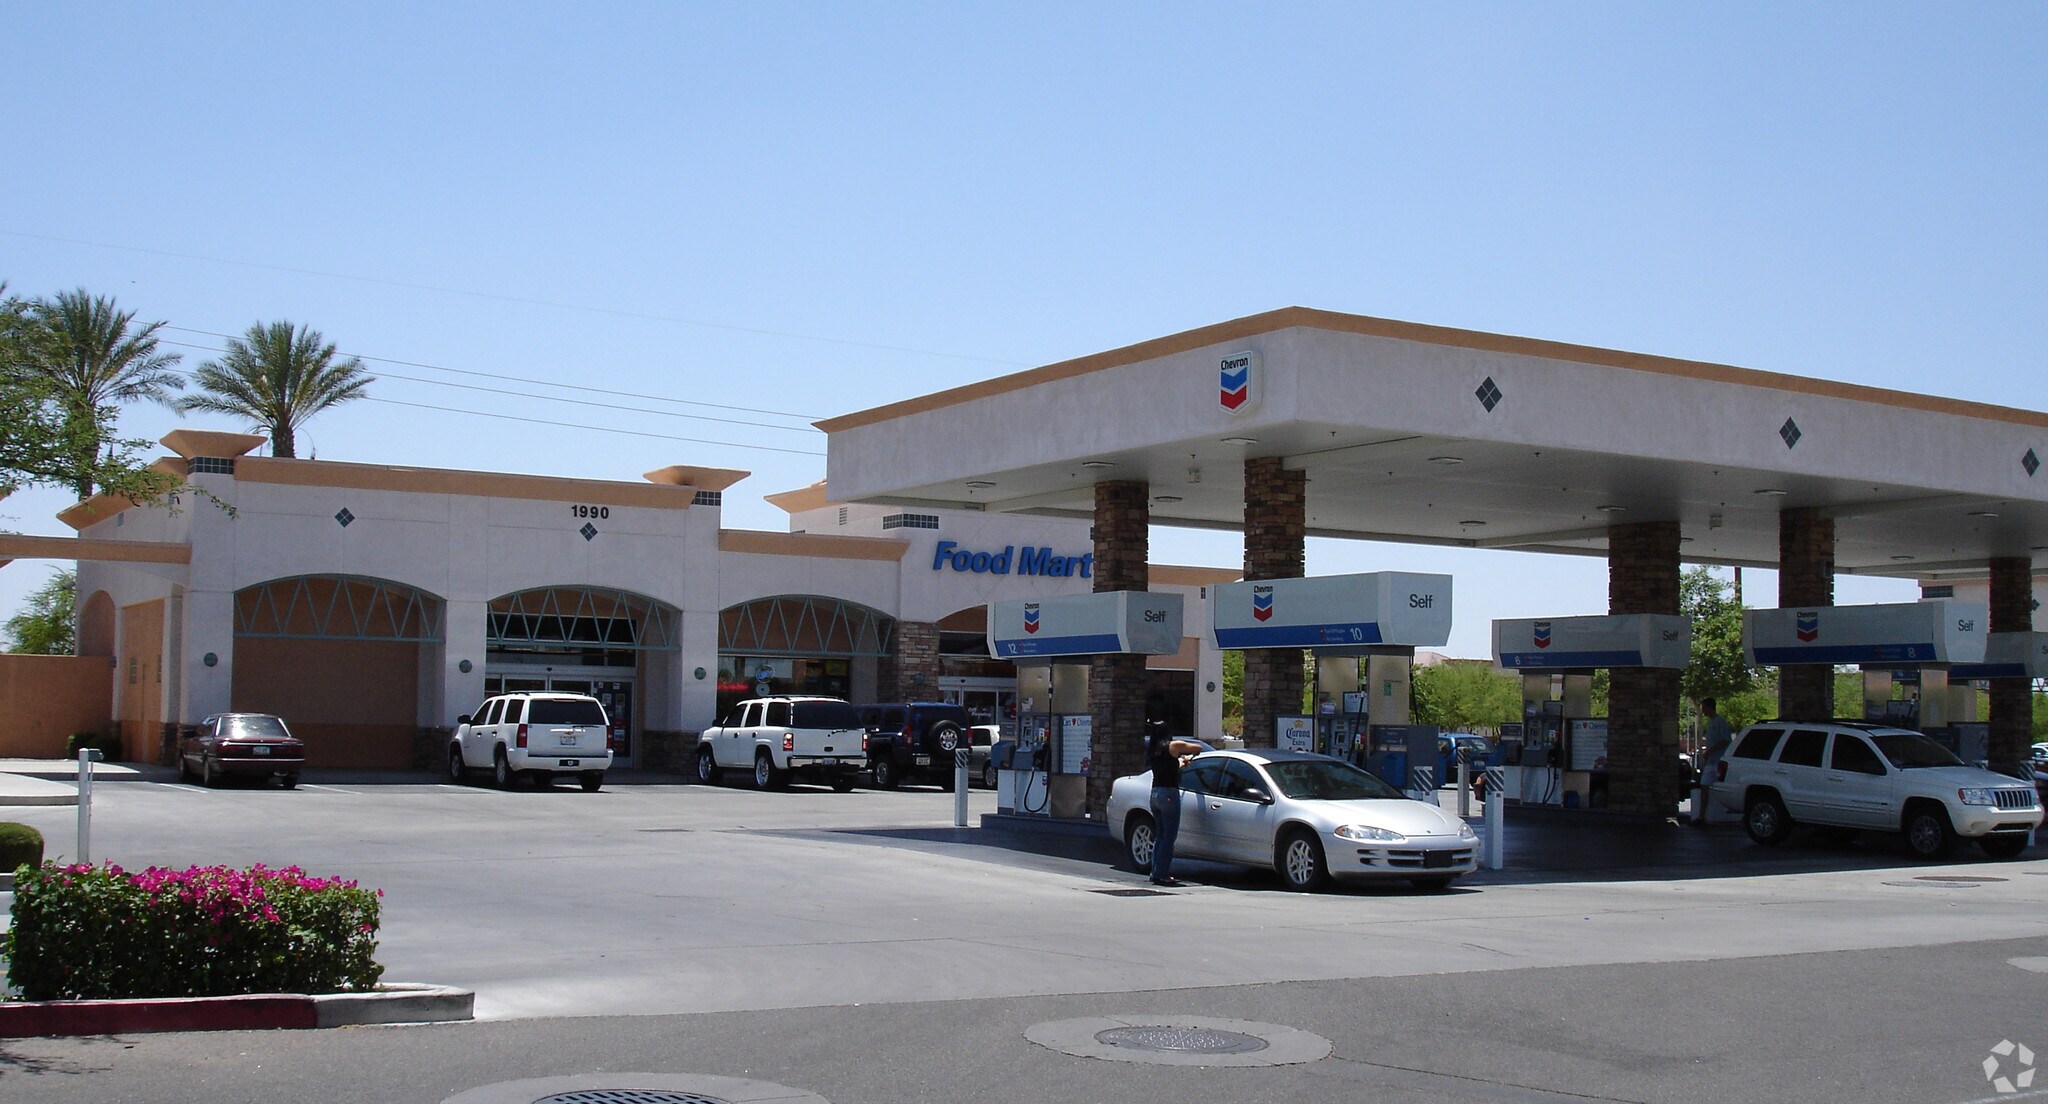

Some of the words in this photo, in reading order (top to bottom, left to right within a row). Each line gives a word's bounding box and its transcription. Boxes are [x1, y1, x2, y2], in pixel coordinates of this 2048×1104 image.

[1221, 357, 1249, 370] Chevron
[571, 504, 610, 520] 1990
[932, 540, 1014, 574] Food
[1017, 546, 1093, 578] Mart
[1253, 585, 1273, 593] Chevron
[1024, 602, 1040, 610] Chevron
[1409, 594, 1434, 609] Self
[1143, 609, 1167, 623] Self
[1958, 619, 1974, 632] Self
[1350, 627, 1364, 641] 10
[1662, 630, 1679, 642] Self
[1007, 642, 1018, 655] 12
[1907, 647, 1917, 658] 8
[1285, 727, 1311, 740] Corona
